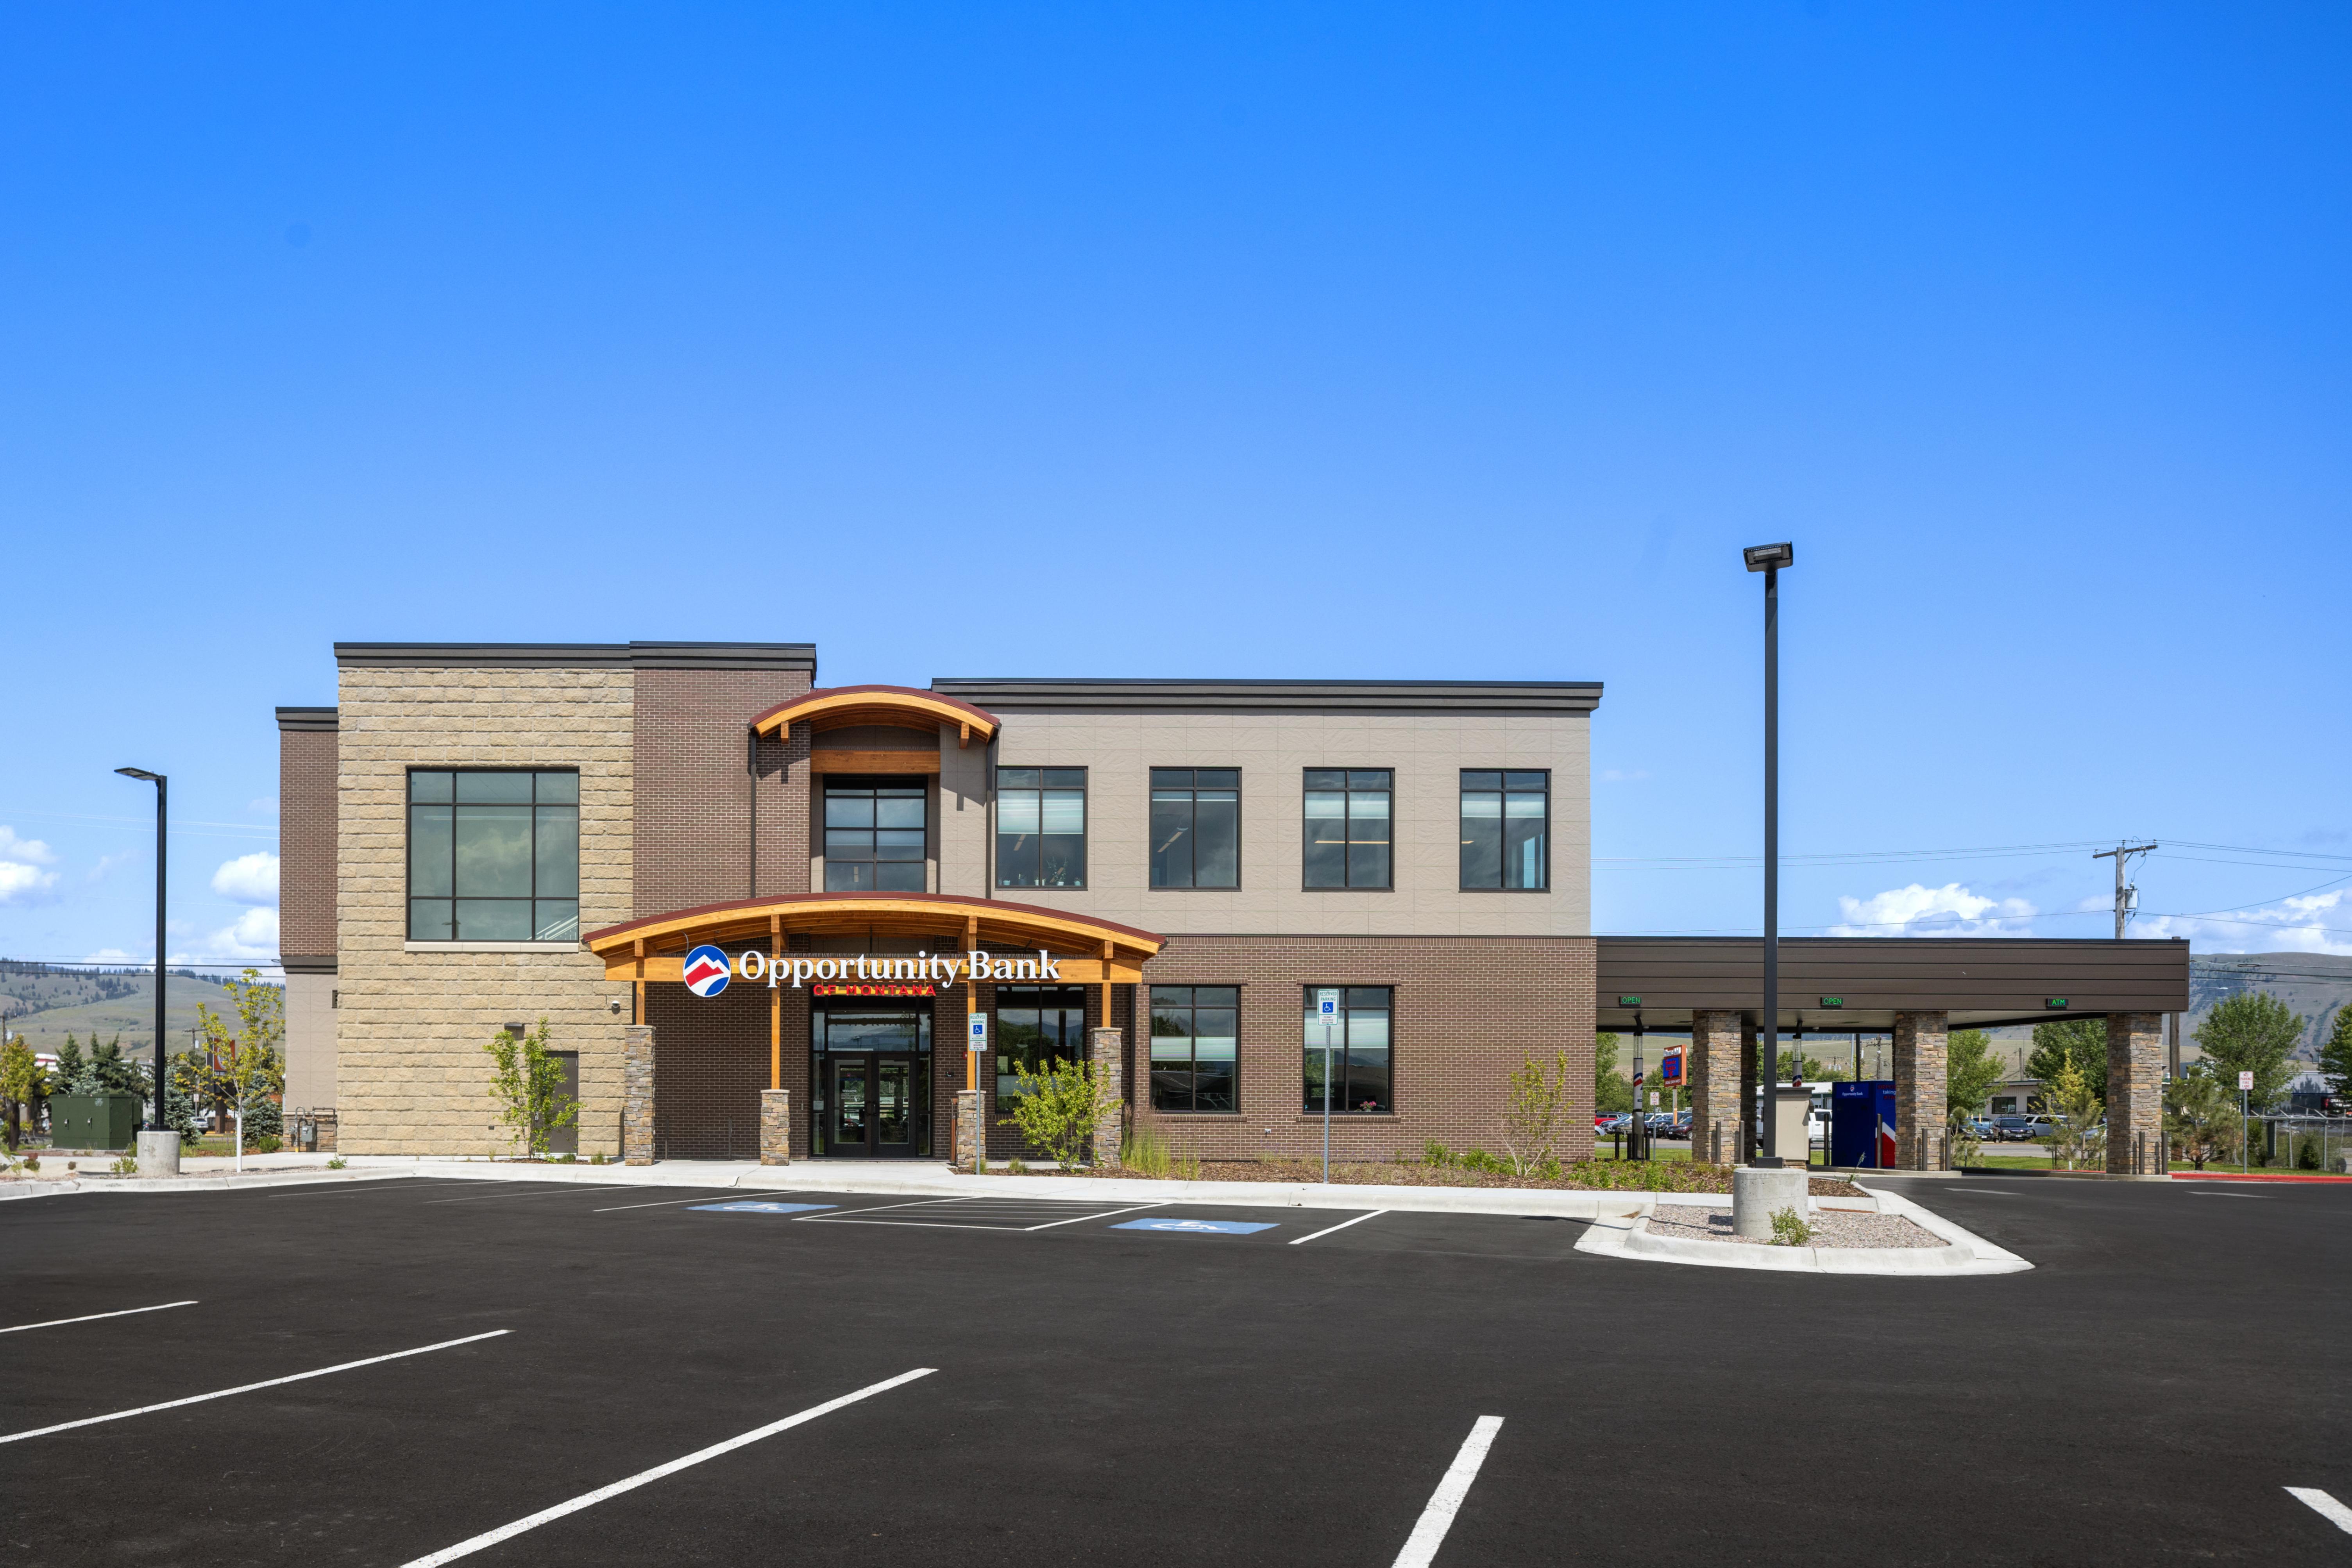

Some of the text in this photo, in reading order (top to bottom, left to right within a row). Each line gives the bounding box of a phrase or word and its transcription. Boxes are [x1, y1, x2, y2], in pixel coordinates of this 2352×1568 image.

[739, 949, 1062, 988] Opportunity Bank
[813, 984, 936, 996] OF MONTANA
